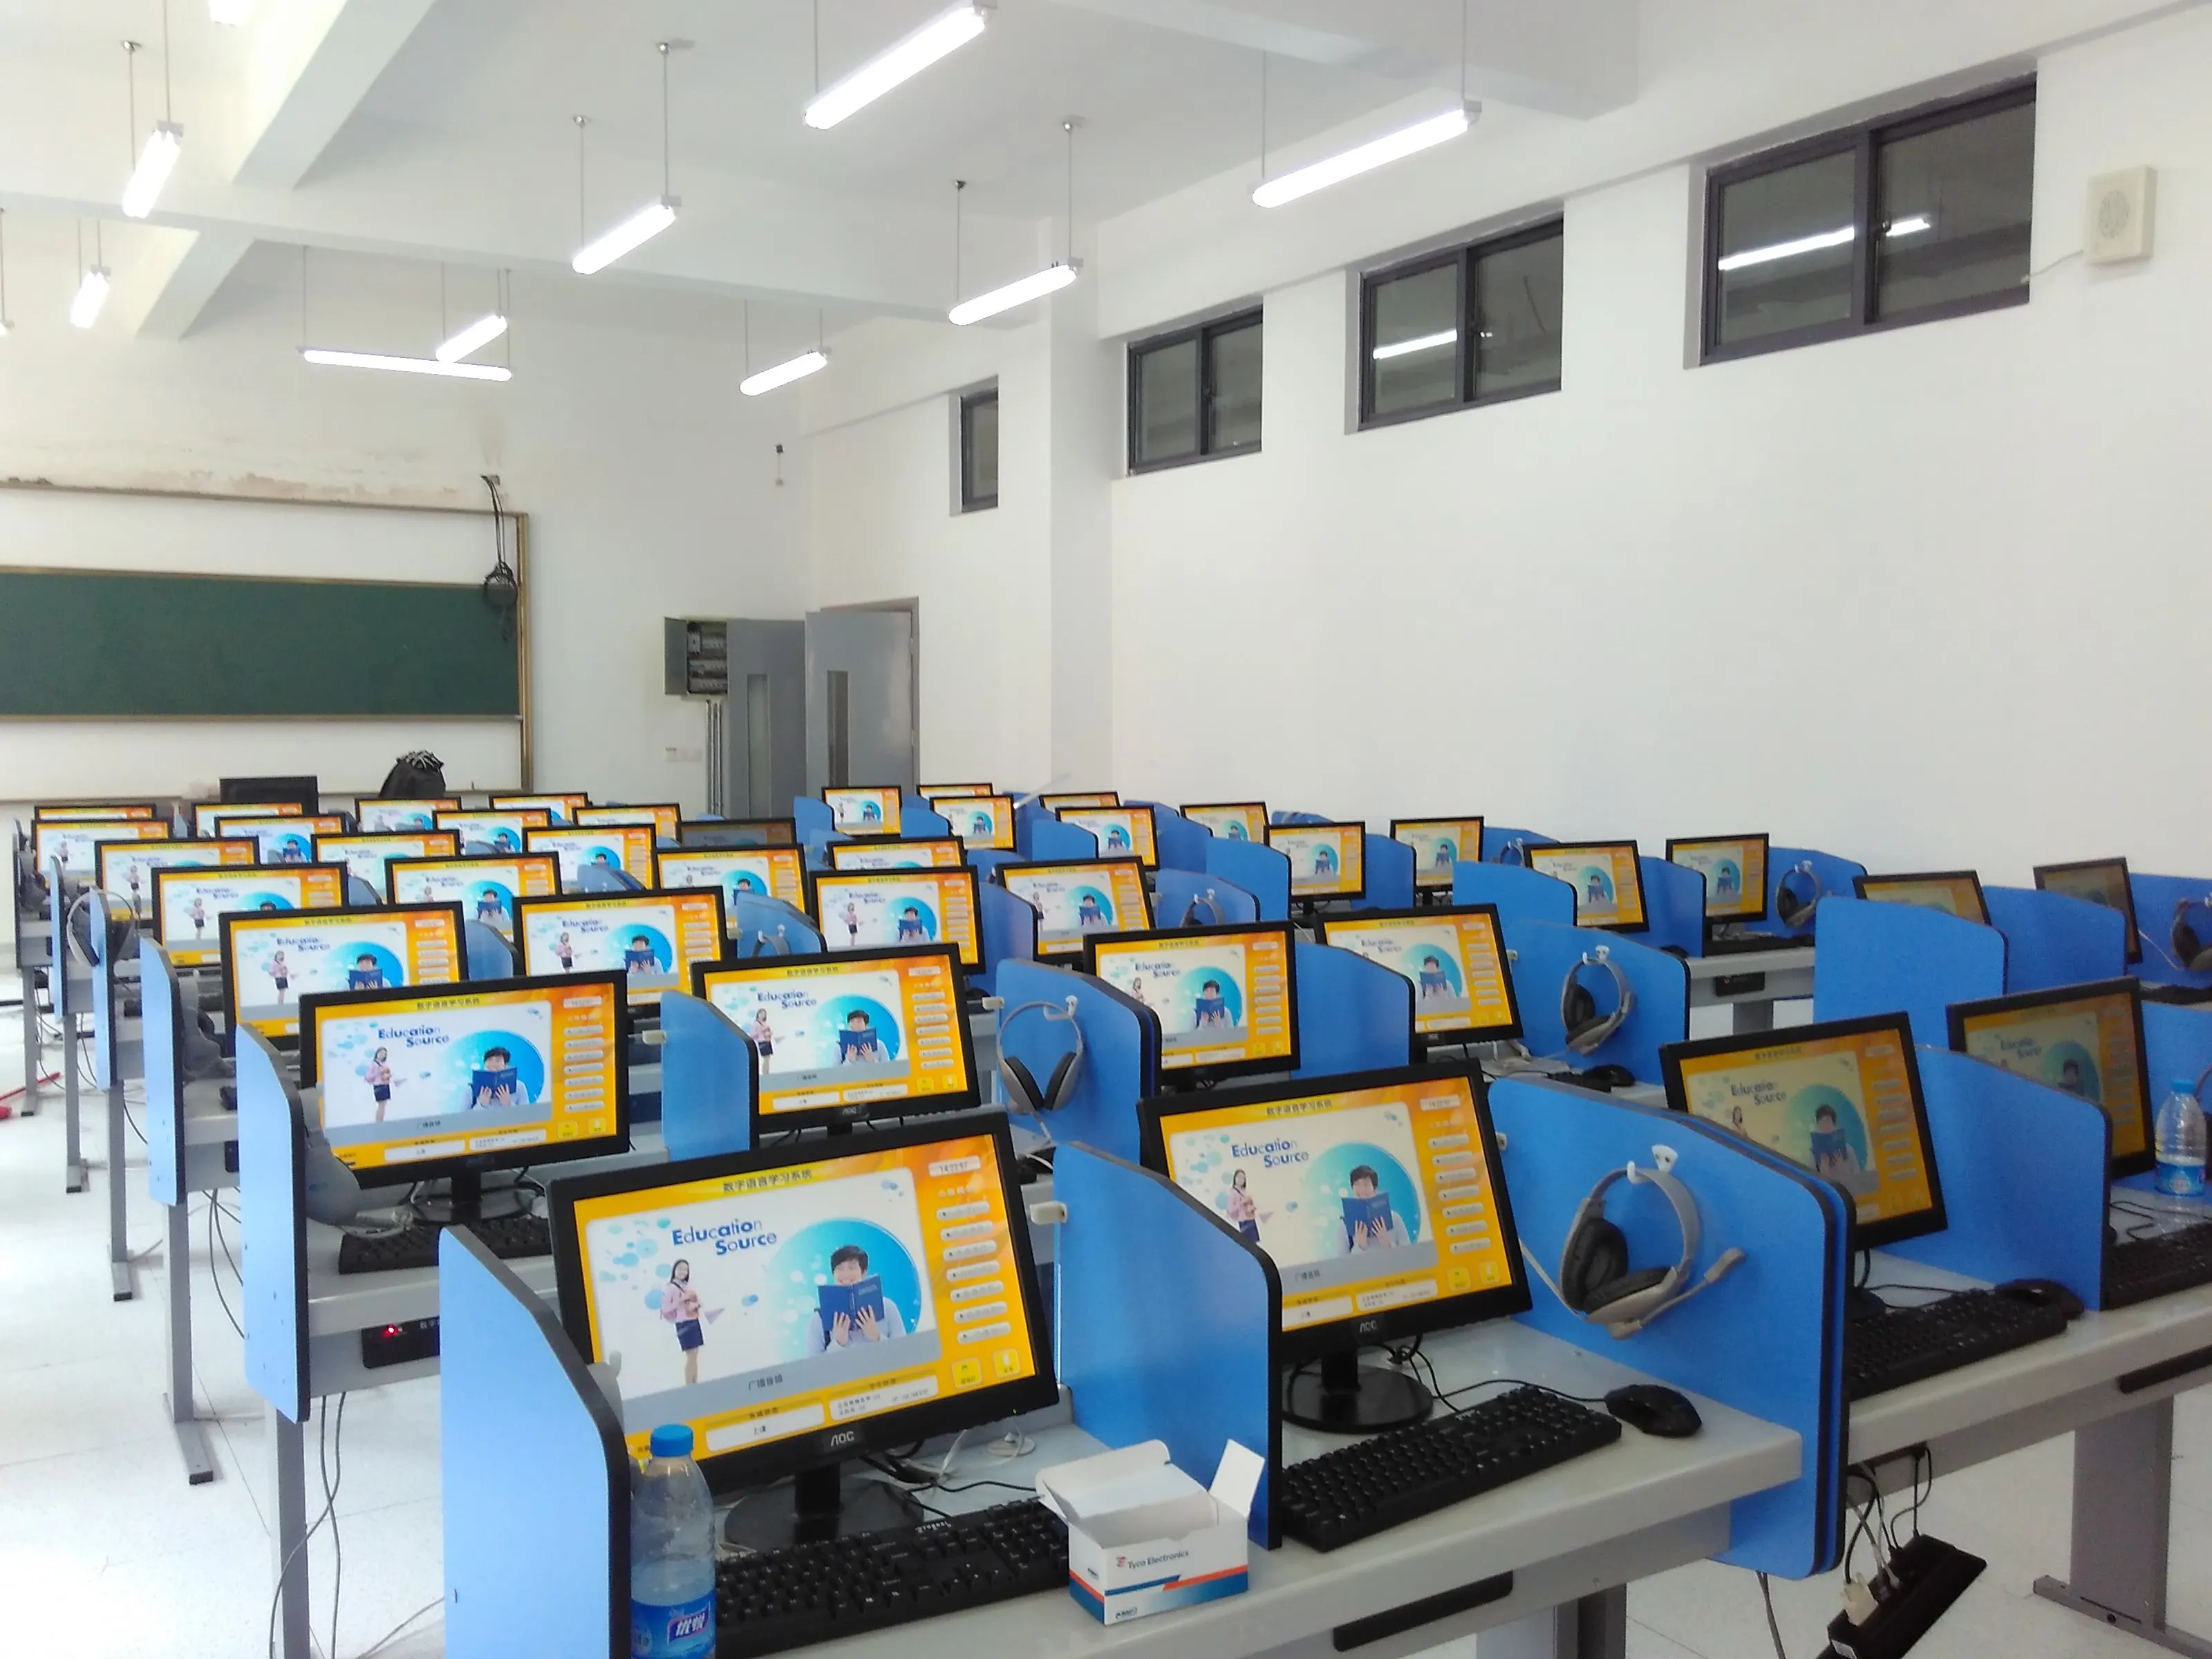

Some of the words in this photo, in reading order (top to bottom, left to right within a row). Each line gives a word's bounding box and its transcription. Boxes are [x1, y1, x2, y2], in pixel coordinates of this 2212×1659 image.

[378, 1024, 441, 1039] Education
[406, 1035, 449, 1047] Source
[1231, 1137, 1297, 1158] Education
[1264, 1152, 1309, 1168] Source
[672, 1219, 762, 1245] Education
[715, 1233, 777, 1255] Source
[1359, 1320, 1378, 1333] AOC
[831, 1431, 854, 1447] AOC
[1127, 1559, 1146, 1570] Tyco
[1147, 1550, 1189, 1565] Electronics
